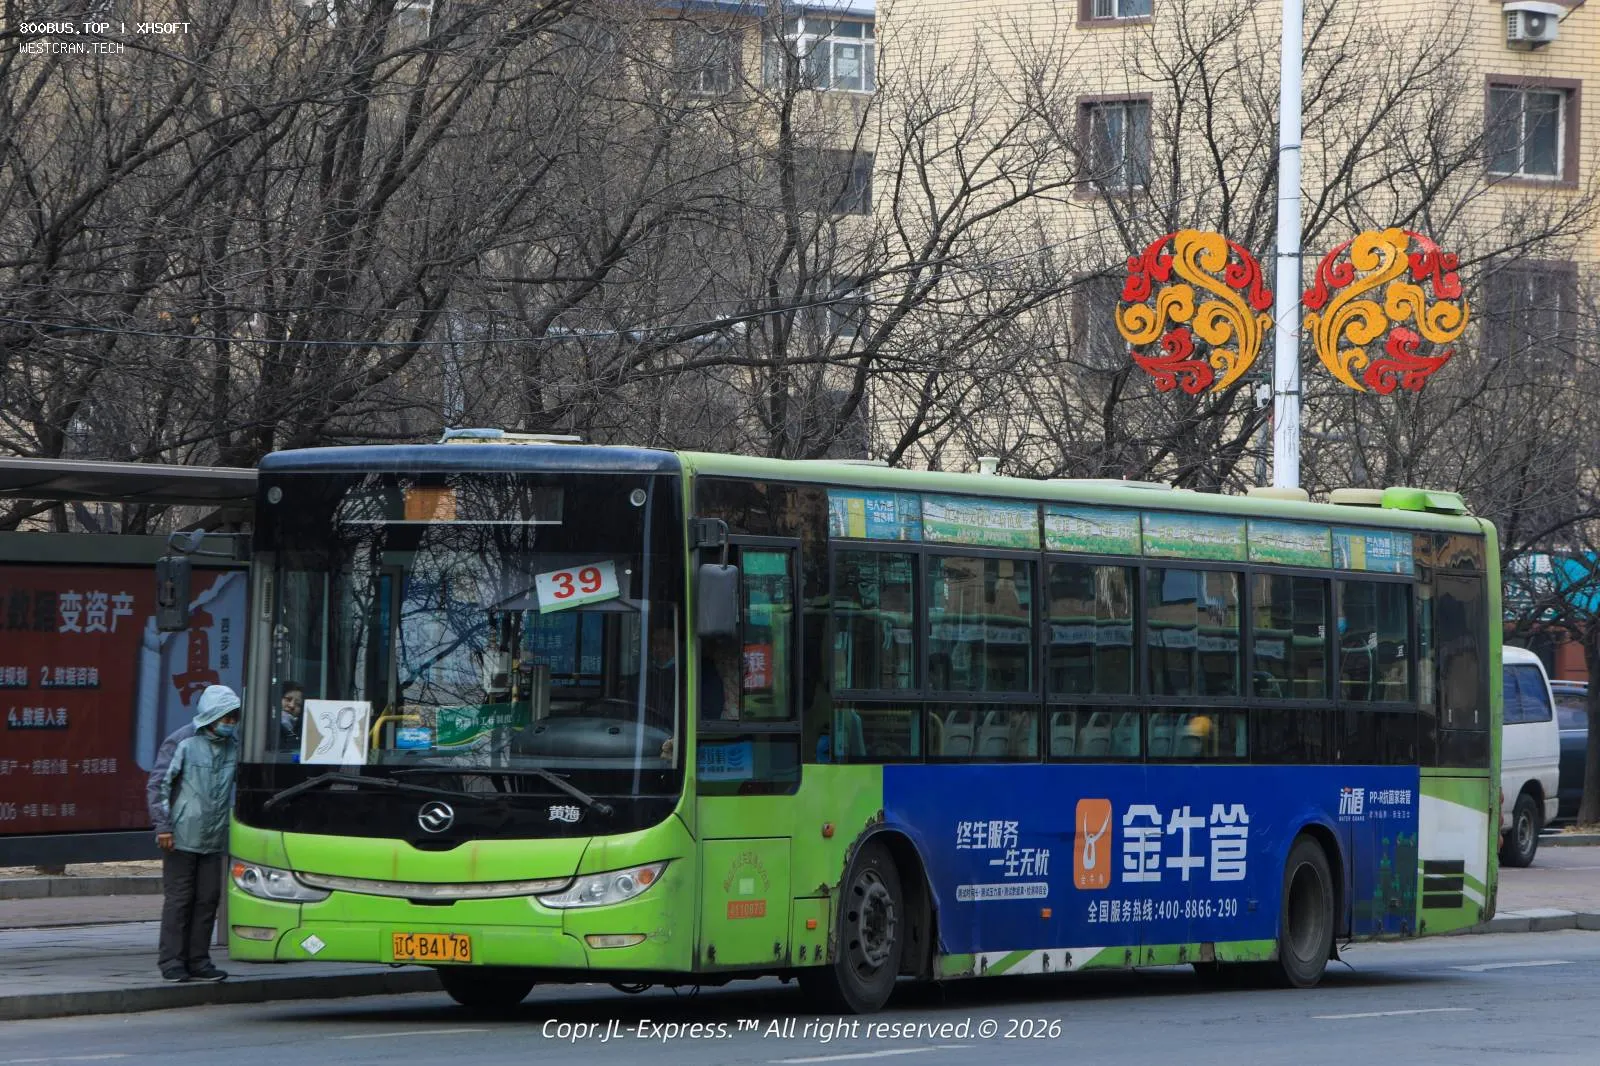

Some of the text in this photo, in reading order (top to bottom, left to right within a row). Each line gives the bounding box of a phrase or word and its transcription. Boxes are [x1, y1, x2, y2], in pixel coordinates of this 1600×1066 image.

[551, 566, 602, 599] 39
[8, 706, 68, 727] 4.数据入表
[316, 706, 357, 759] 39
[548, 805, 581, 822] 黄海
[956, 820, 1019, 850] 终生服务
[1122, 803, 1250, 883] 金牛管
[989, 848, 1050, 877] 一生无忧
